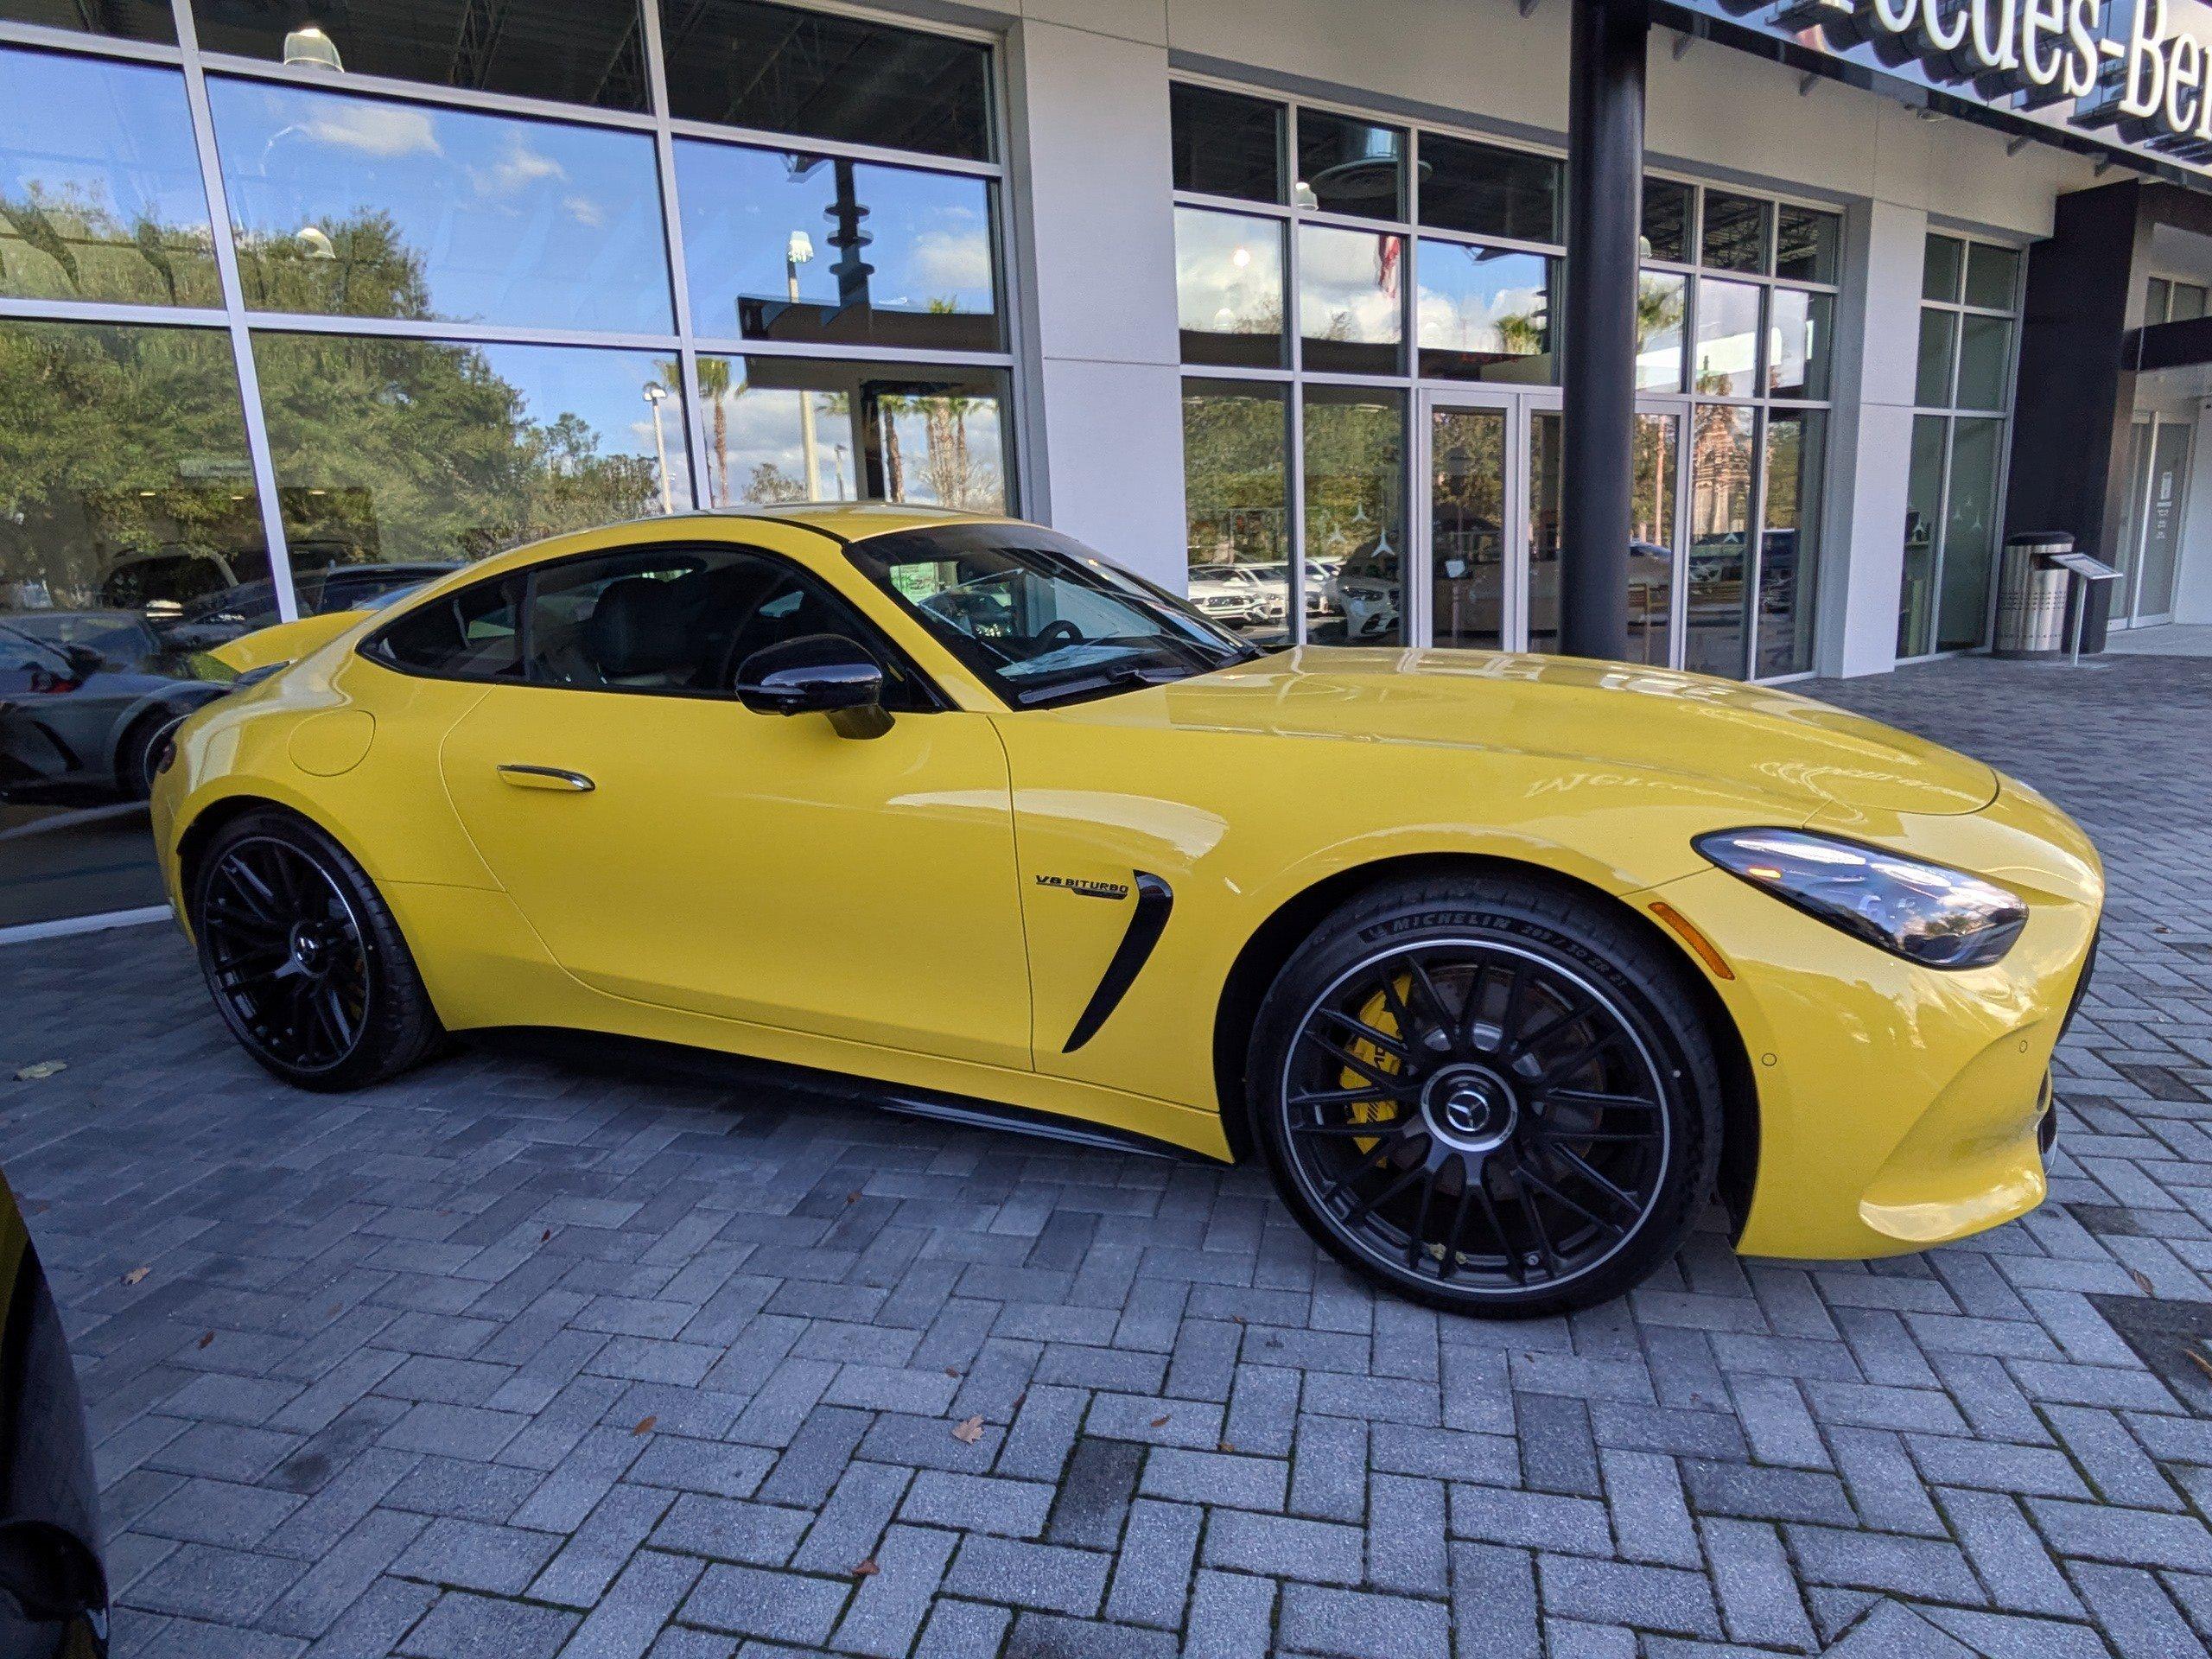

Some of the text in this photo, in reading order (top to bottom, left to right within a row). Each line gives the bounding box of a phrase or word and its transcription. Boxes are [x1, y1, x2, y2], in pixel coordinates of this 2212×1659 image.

[1036, 874, 1129, 893] V8 BITURBO
[1390, 912, 1510, 931] MICHELIN
